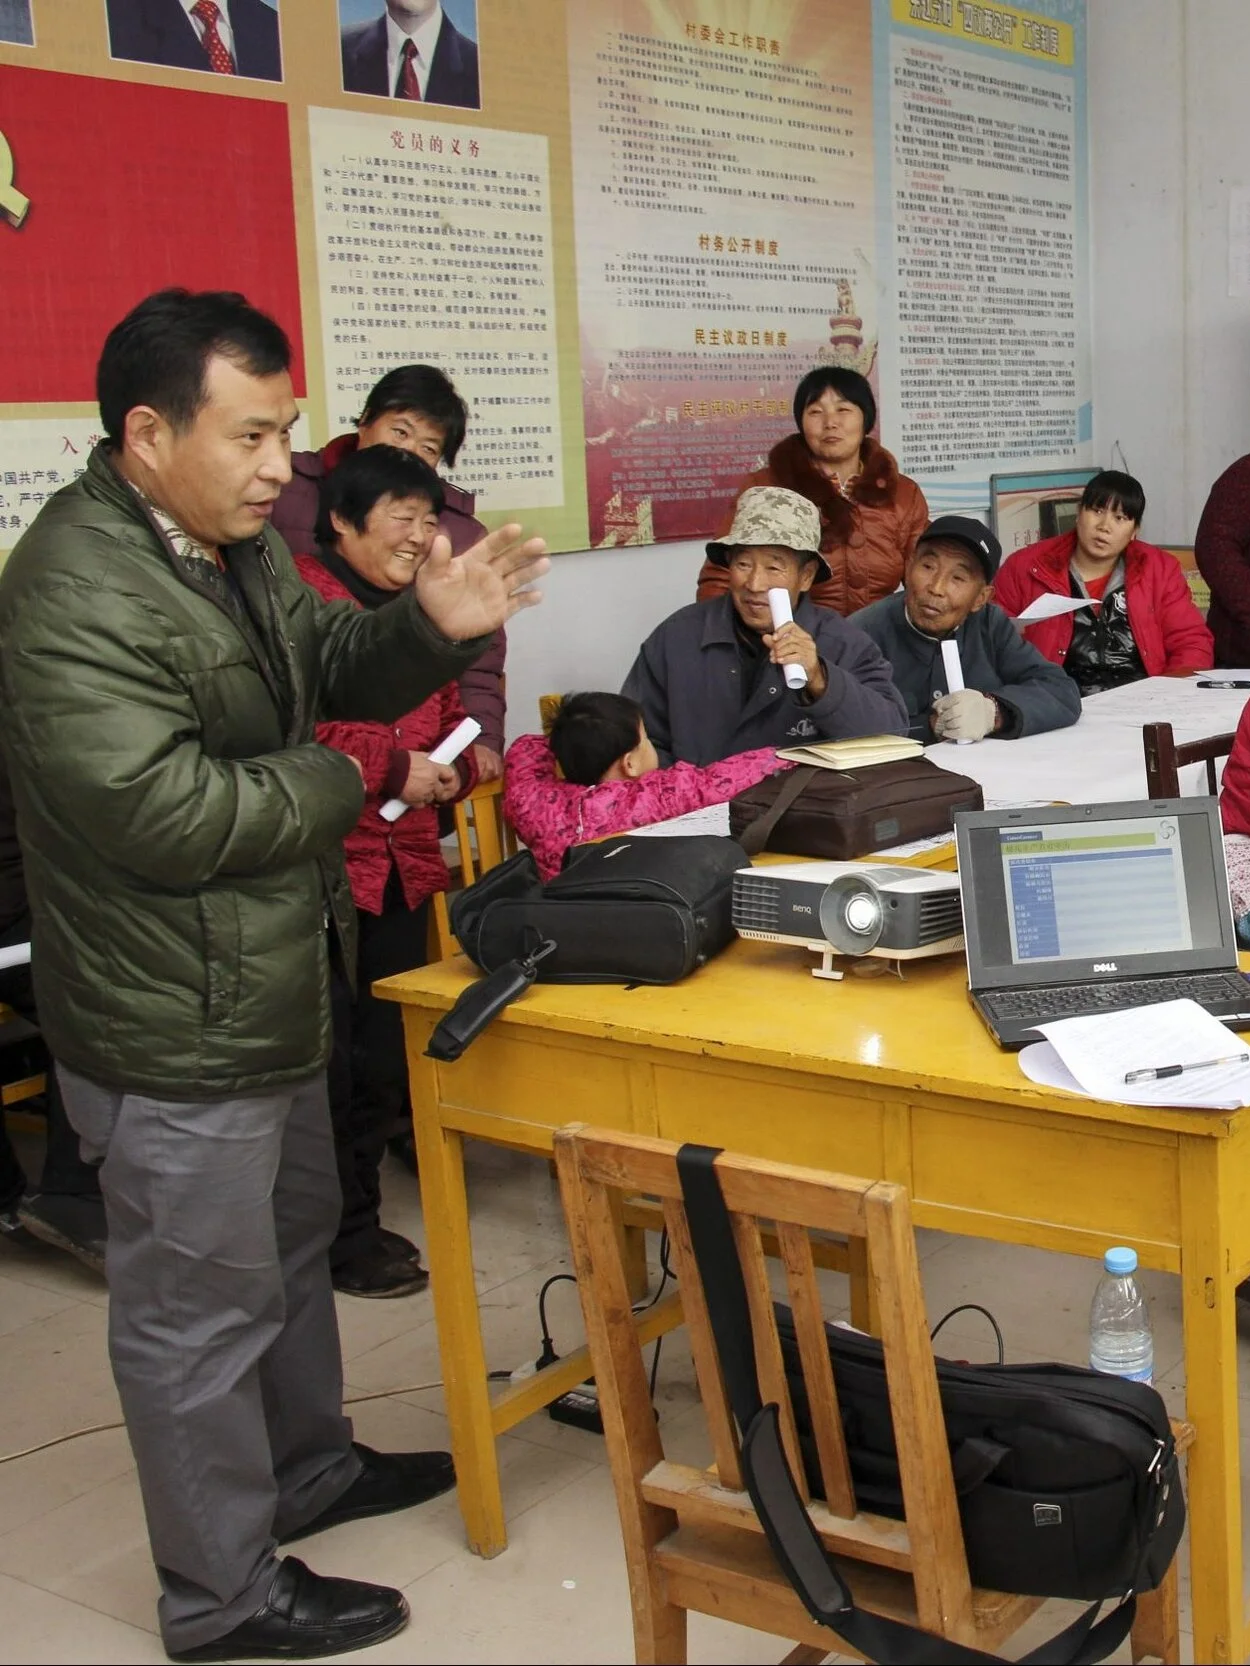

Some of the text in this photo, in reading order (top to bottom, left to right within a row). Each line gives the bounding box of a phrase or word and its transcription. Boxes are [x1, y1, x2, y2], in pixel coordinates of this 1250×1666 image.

[685, 22, 782, 57] 村委会工作职责
[390, 129, 480, 158] 党员的义务
[698, 233, 779, 257] 村务公开制度
[695, 328, 788, 347] 民主议政日制度
[1093, 962, 1118, 973] DELL
